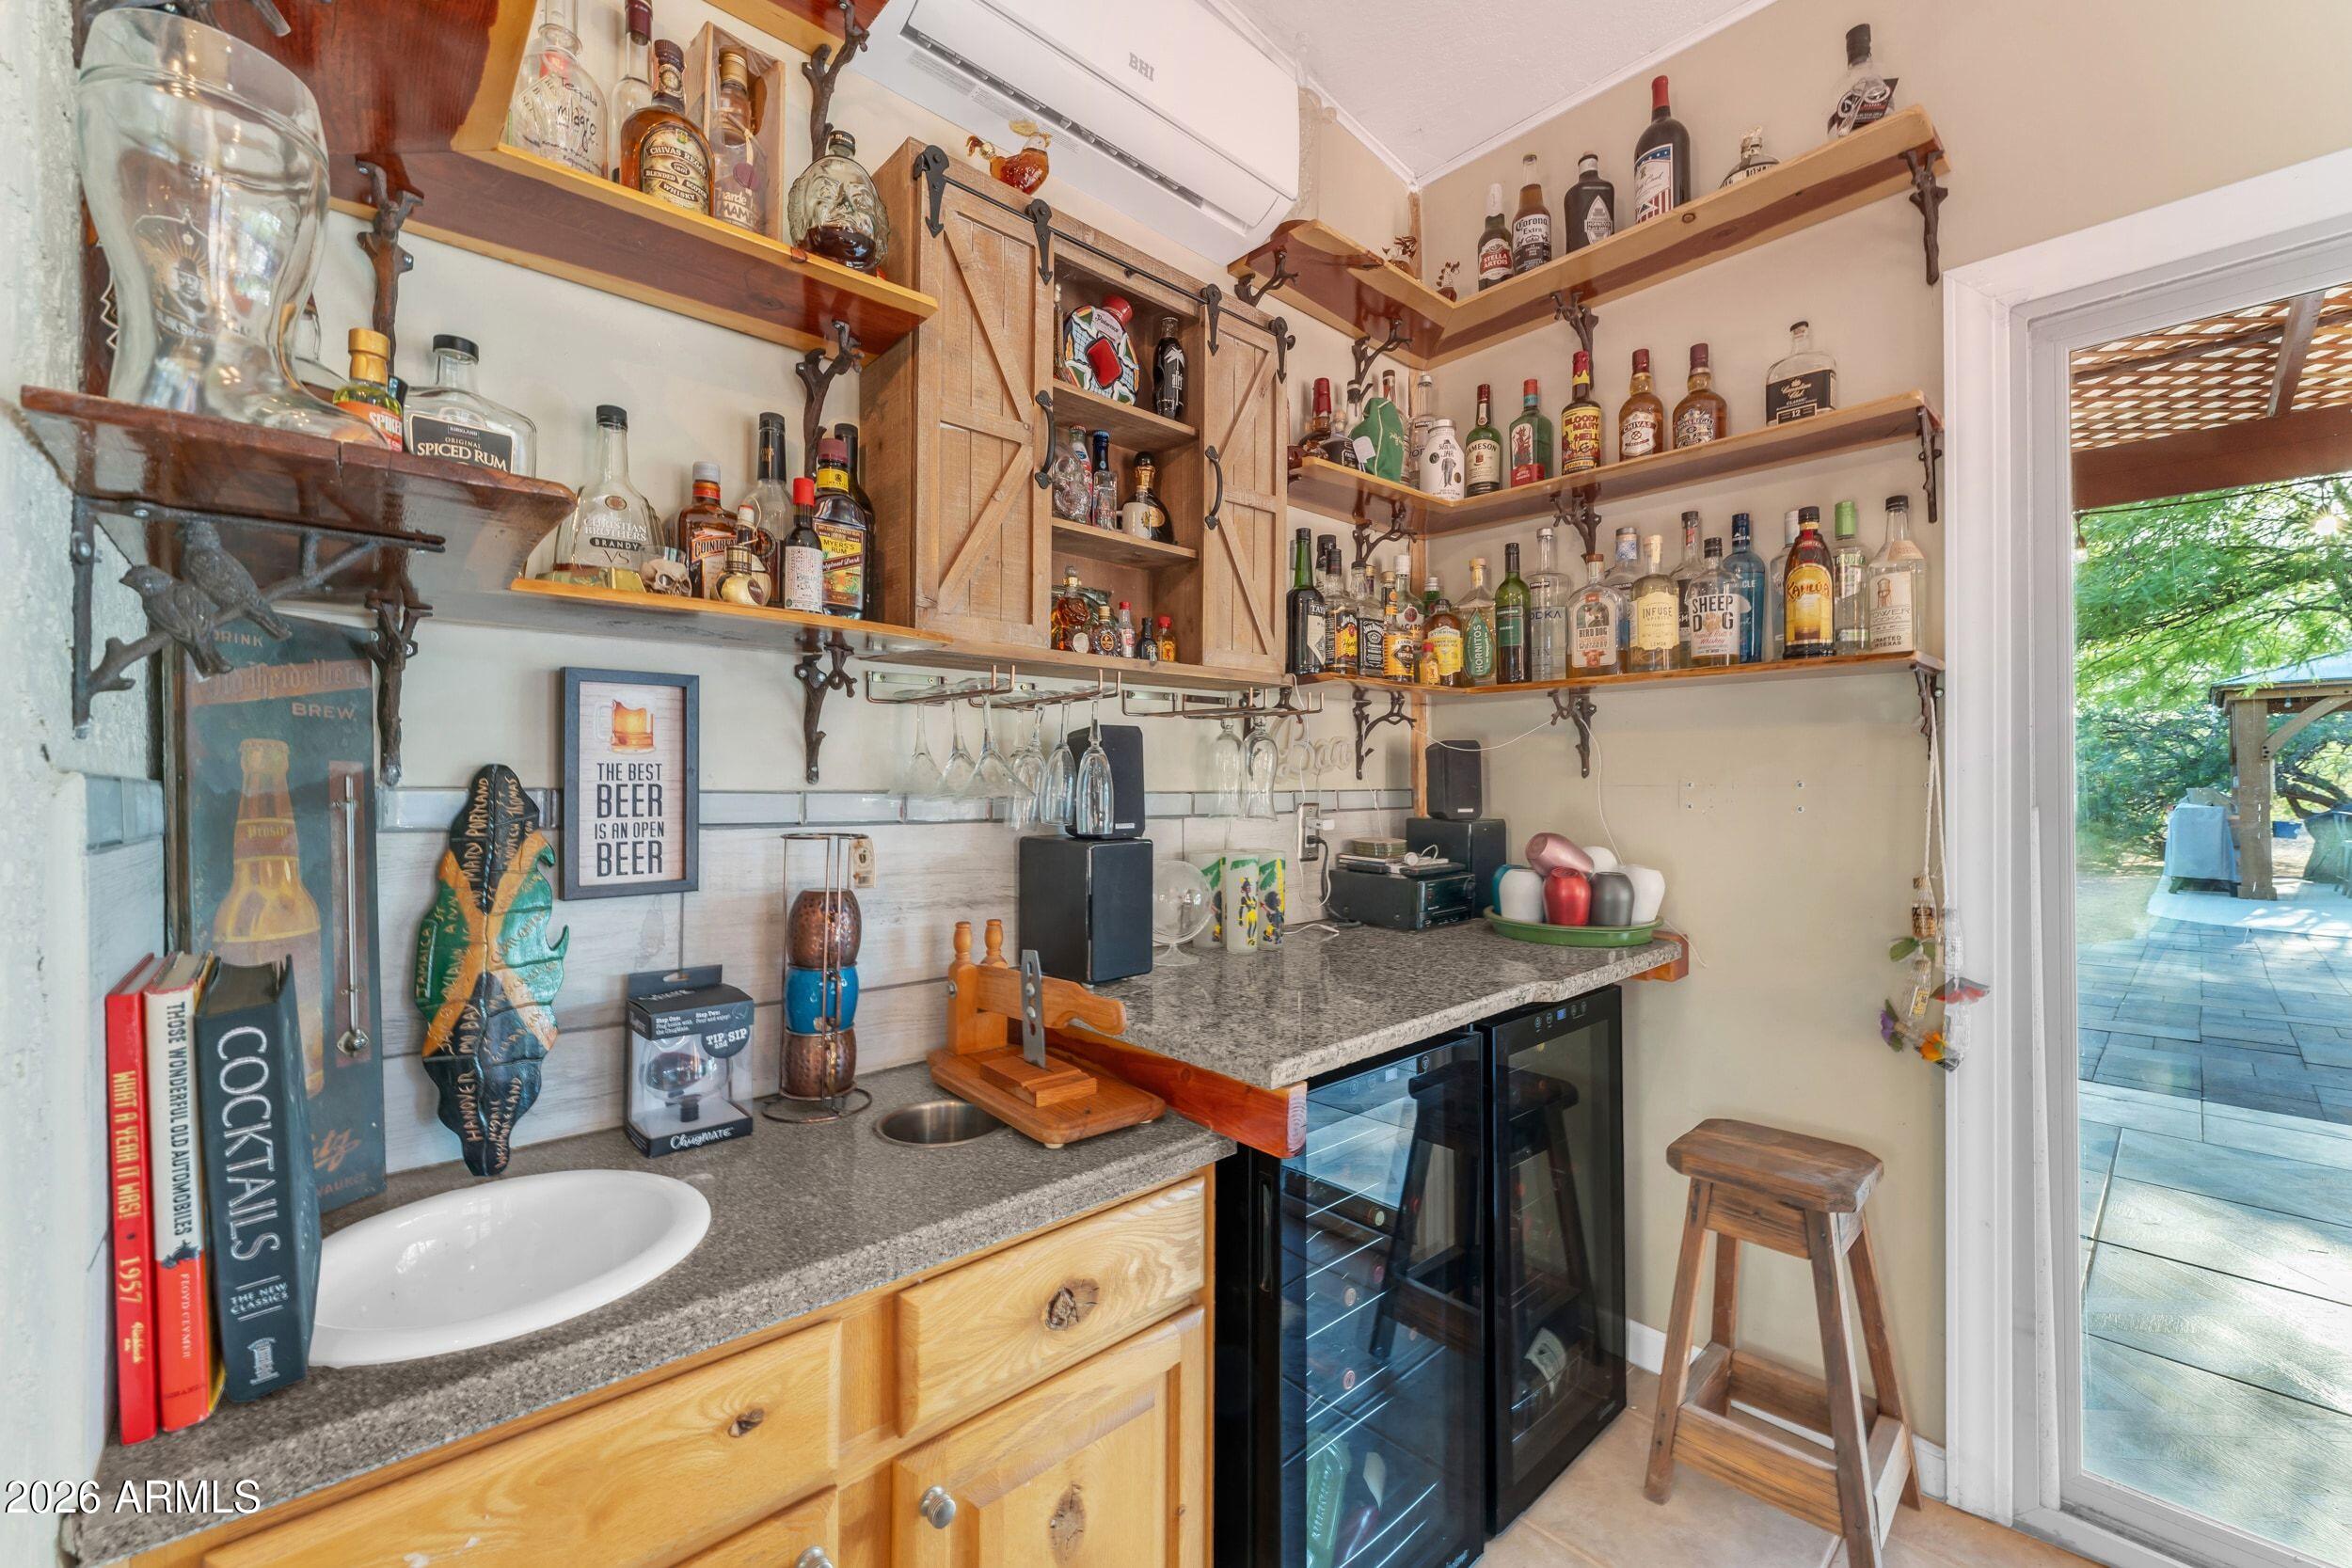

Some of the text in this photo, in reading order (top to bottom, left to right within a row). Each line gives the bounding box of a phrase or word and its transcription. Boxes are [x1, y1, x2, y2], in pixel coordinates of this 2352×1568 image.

[650, 147, 681, 158] CHIVAS
[645, 170, 675, 182] BLENDED
[663, 183, 696, 201] WHISKY
[1516, 217, 1548, 232] Corona
[1523, 227, 1543, 235] Extra
[1484, 254, 1507, 263] STELLA
[1484, 259, 1508, 269] ARTOIS
[1565, 414, 1599, 427] BLOODY
[1791, 409, 1801, 418] 12
[1572, 422, 1599, 432] MARY
[445, 436, 482, 450] ORIGINAL
[417, 443, 472, 460] SPICED
[474, 450, 508, 472] RUM
[583, 518, 647, 534] CHRISTIAN
[584, 528, 647, 542] BROTHERS
[594, 539, 640, 551] BRANDY
[602, 549, 629, 564] VS
[1643, 607, 1673, 619] INFUSE
[1692, 594, 1734, 614] SHEEP
[1579, 626, 1608, 638] BIRD DOG
[1473, 624, 1483, 675] HORNITOS
[596, 763, 662, 781] THE BEST
[596, 784, 662, 818] BEER
[595, 821, 664, 840] IS AN OPEN
[596, 840, 662, 877] BEER
[415, 927, 432, 999] JAMAICA
[706, 1027, 748, 1045] TIP SIP
[715, 1040, 728, 1049] and
[455, 1069, 485, 1142] HANOVER
[167, 1002, 194, 1237] THOSE WONDERFUL OLD AUTOMOBILES
[113, 1070, 141, 1221] WHAT A YEAR IT WAS!
[217, 1025, 282, 1261] COCKTAILS
[119, 1256, 143, 1305] 1957
[180, 1273, 191, 1310] FLOYD
[230, 1282, 288, 1305] THE NEW
[230, 1291, 289, 1315] CLASSICS
